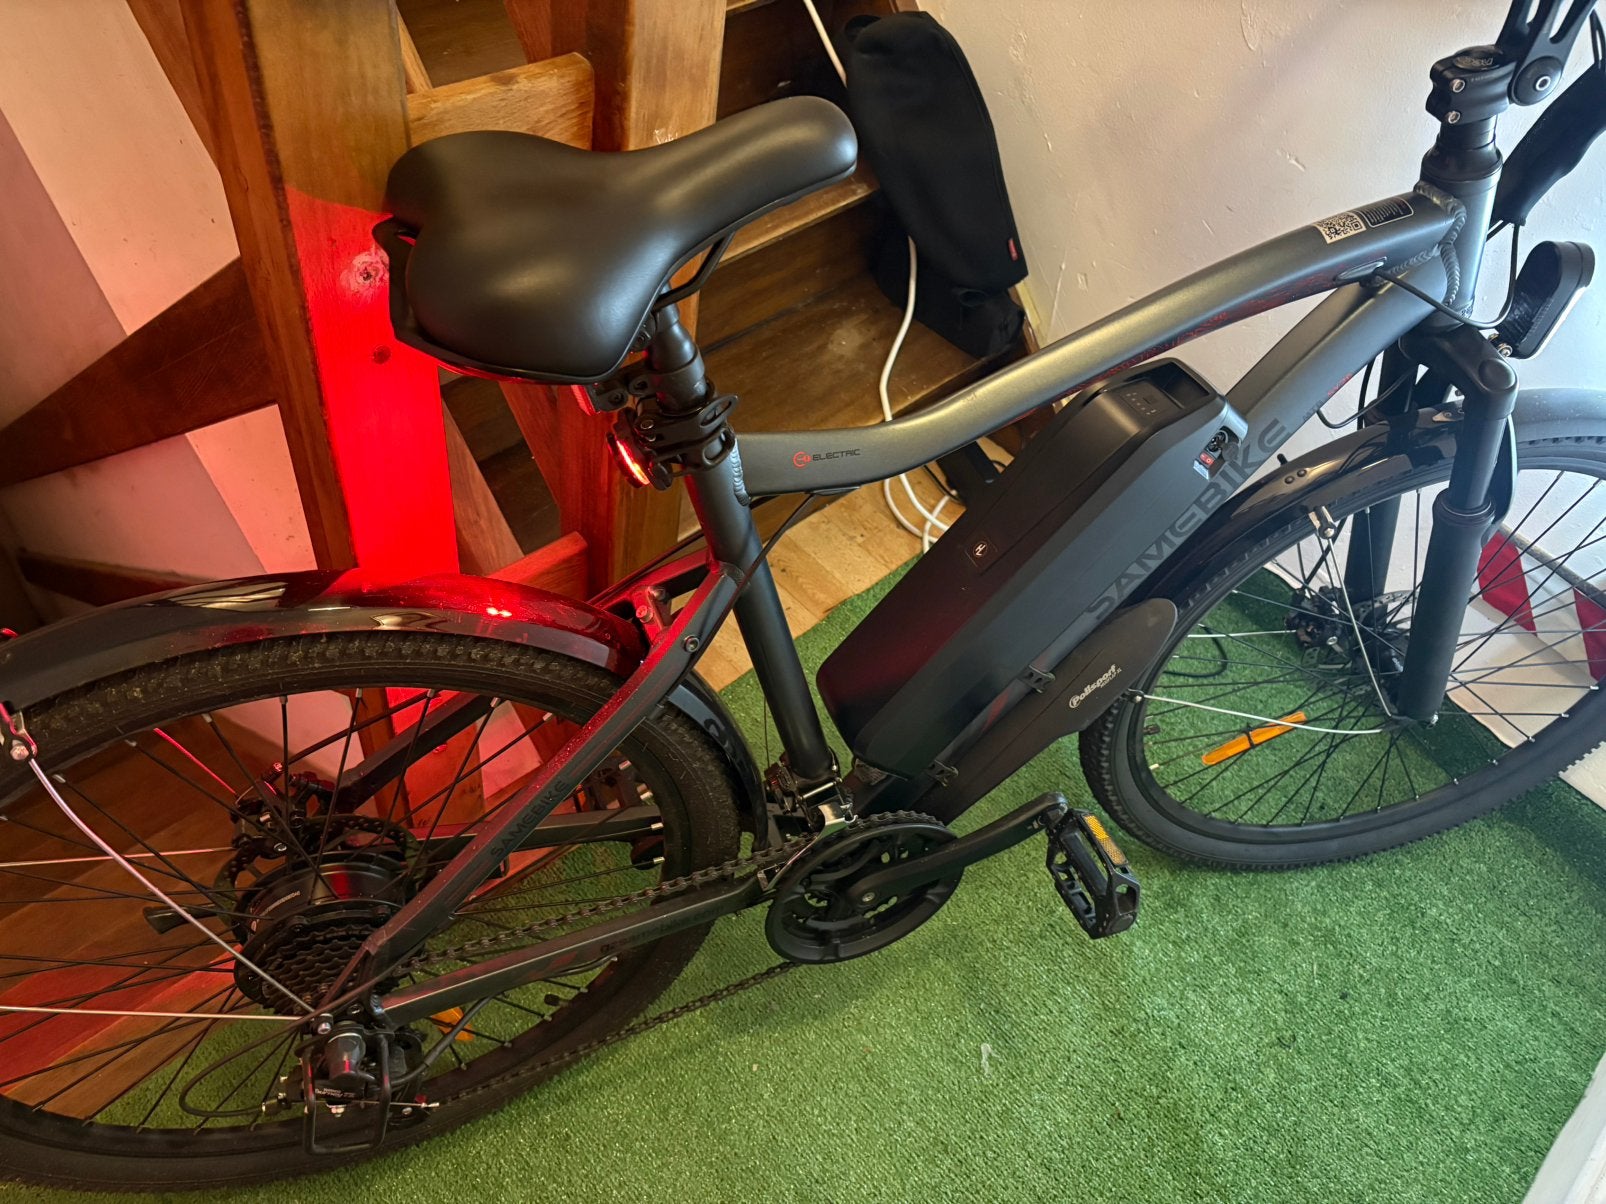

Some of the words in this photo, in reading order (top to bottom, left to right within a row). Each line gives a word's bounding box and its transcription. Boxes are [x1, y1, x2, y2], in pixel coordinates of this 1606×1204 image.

[812, 448, 861, 461] ELECTRIC
[1084, 418, 1291, 620] SAMEBIKE
[1069, 664, 1116, 708] Polisport
[490, 781, 569, 856] SAMEBIKE
